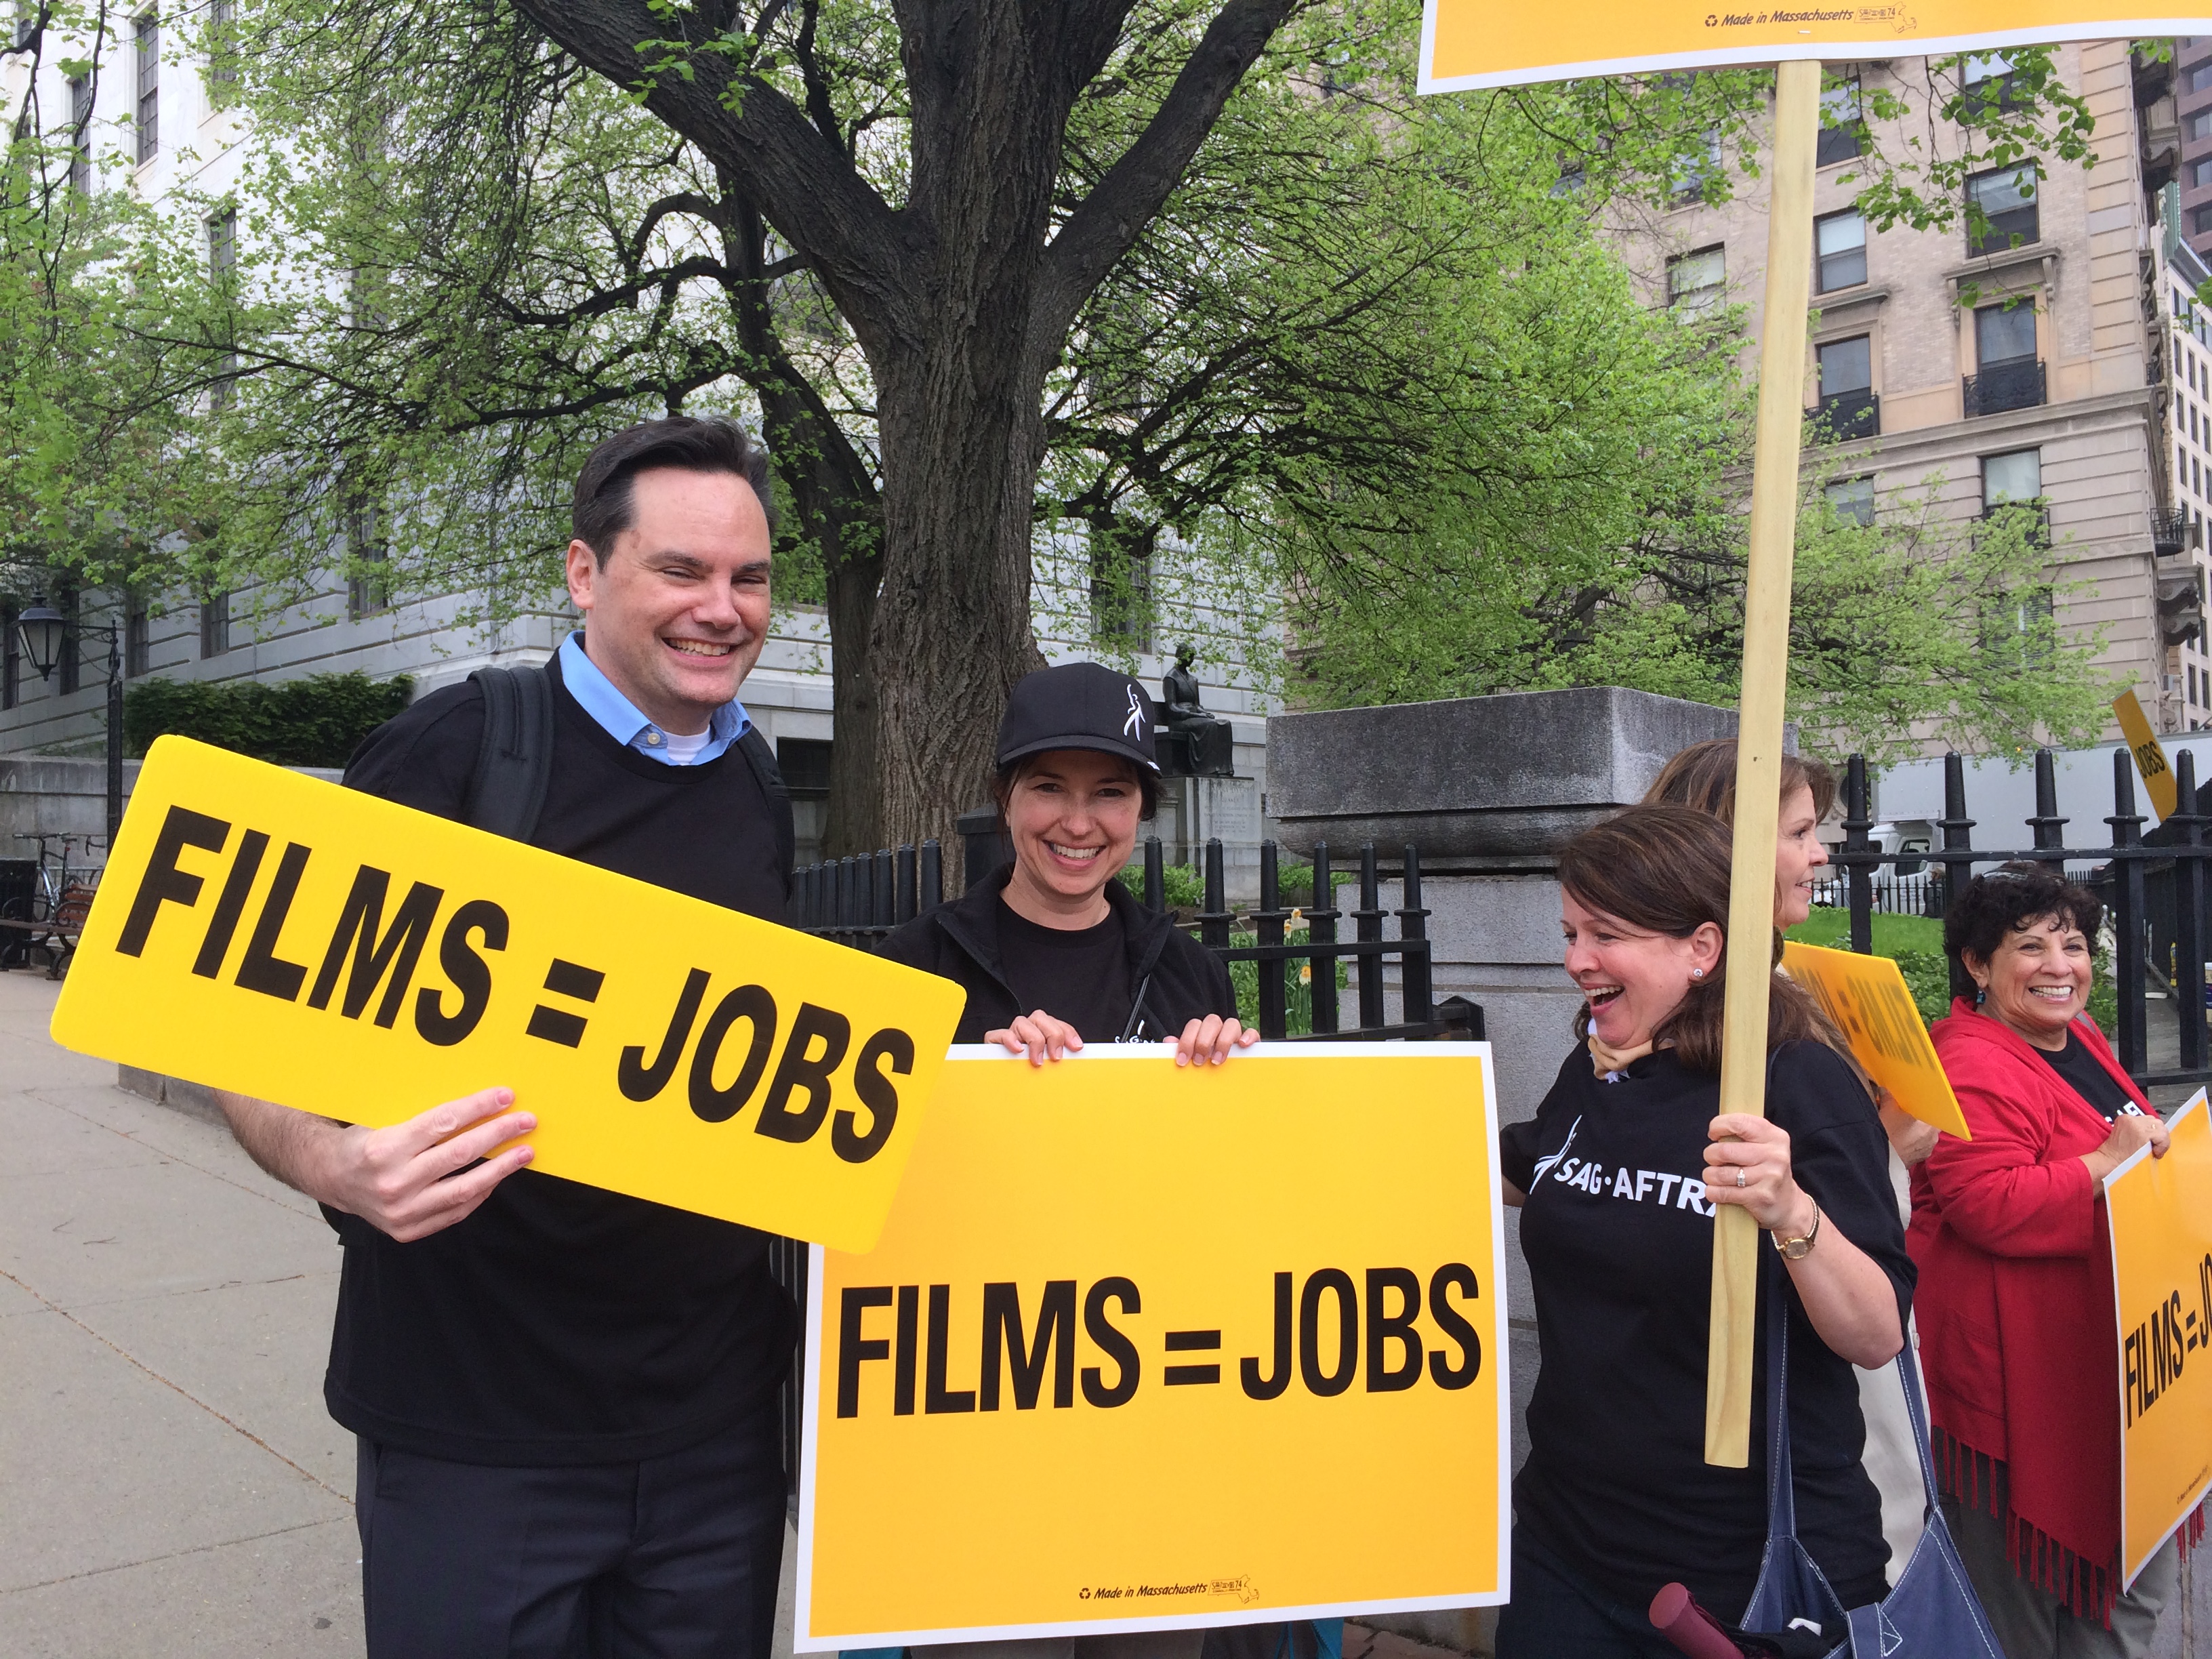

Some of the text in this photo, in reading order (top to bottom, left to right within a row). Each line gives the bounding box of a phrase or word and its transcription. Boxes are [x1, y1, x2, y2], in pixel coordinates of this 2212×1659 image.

[1721, 14, 1754, 26] Made
[1757, 12, 1767, 24] in
[1769, 8, 1854, 23] Massachusetts
[1887, 8, 1896, 16] 74
[2135, 740, 2165, 779] JOBS
[116, 805, 914, 1163] FILMS = JOBS
[1554, 1158, 1717, 1217] SAG·AFTR
[838, 1263, 1481, 1418] FILMS = JOBS
[2125, 1290, 2184, 1430] FILMS
[2186, 1309, 2198, 1353] =
[1094, 1586, 1123, 1599] Made
[1125, 1586, 1134, 1597] in
[1136, 1583, 1208, 1597] Massachusetts
[1235, 1580, 1242, 1588] 74
